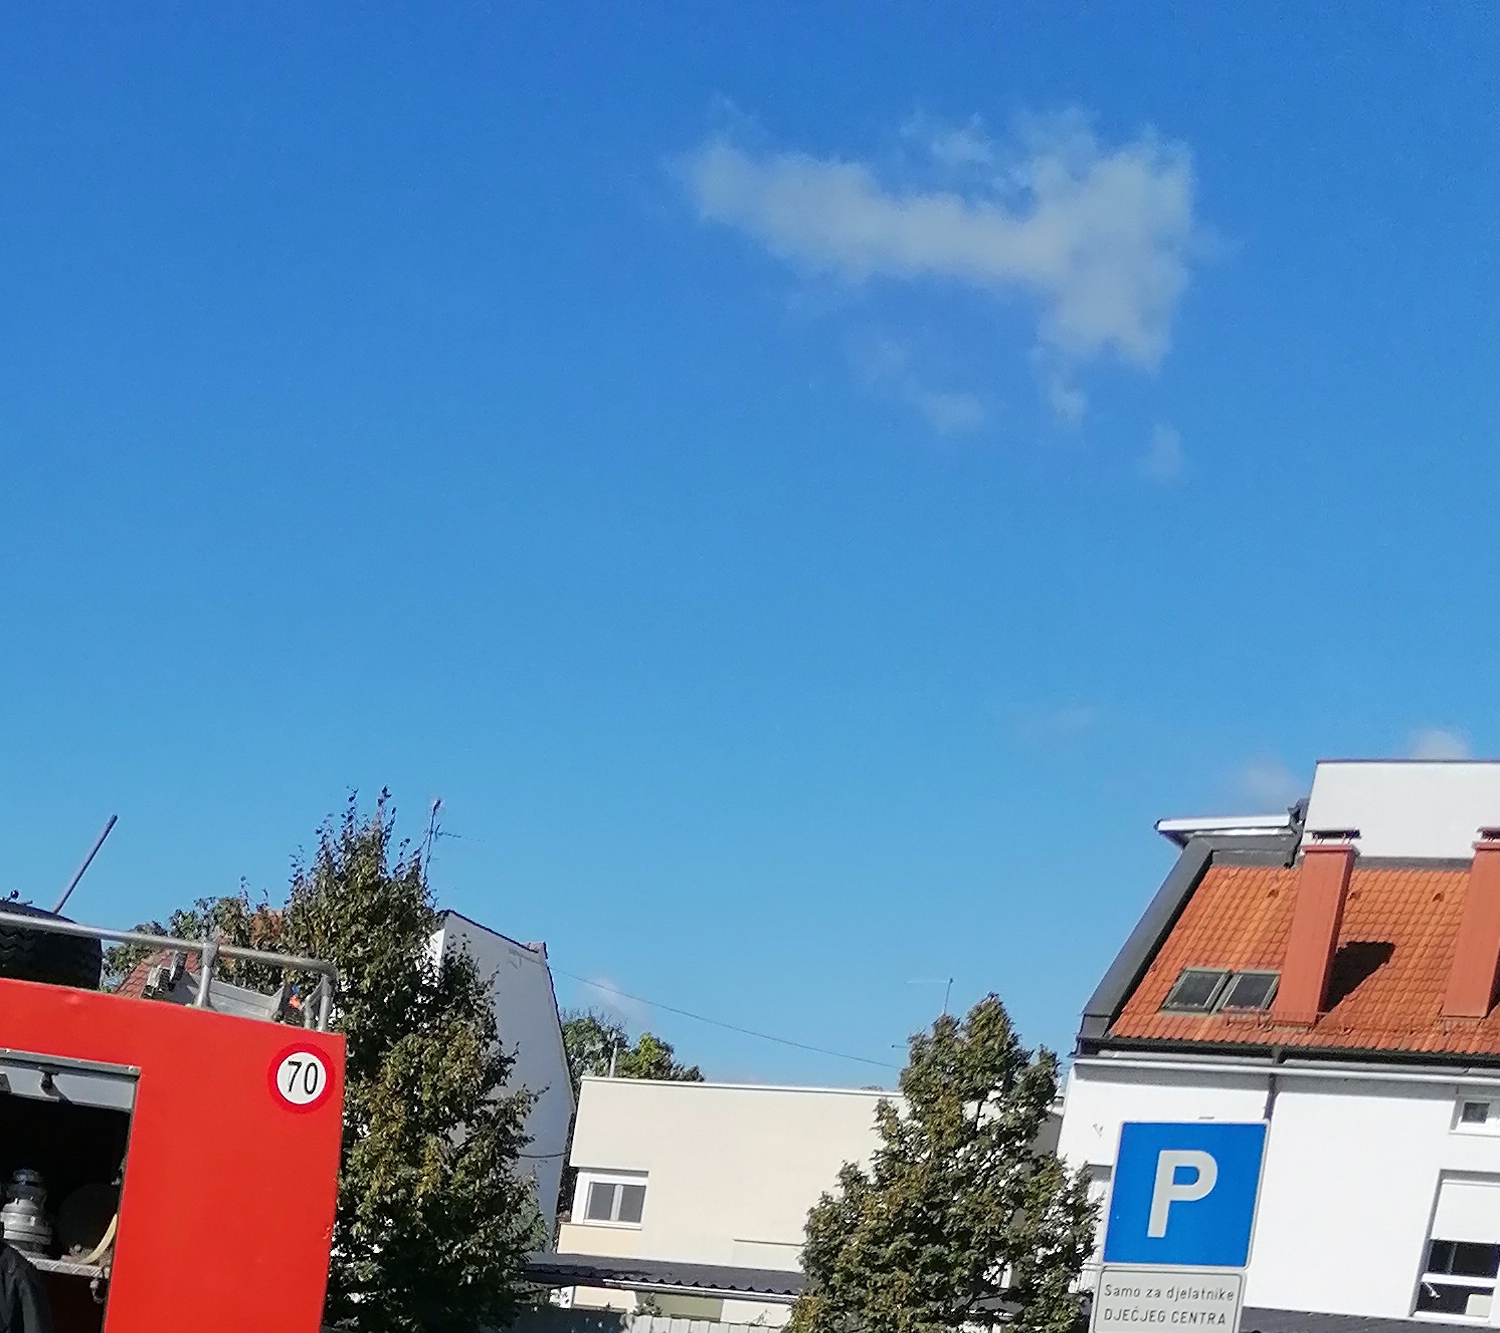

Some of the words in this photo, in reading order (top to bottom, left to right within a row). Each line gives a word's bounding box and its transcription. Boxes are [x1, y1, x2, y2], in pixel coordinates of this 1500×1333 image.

[287, 1060, 318, 1095] 70
[1147, 1149, 1218, 1238] P
[1104, 1284, 1141, 1298] Samo
[1146, 1288, 1161, 1299] za
[1166, 1285, 1235, 1302] djelatnike
[1171, 1311, 1226, 1326] CENTRA
